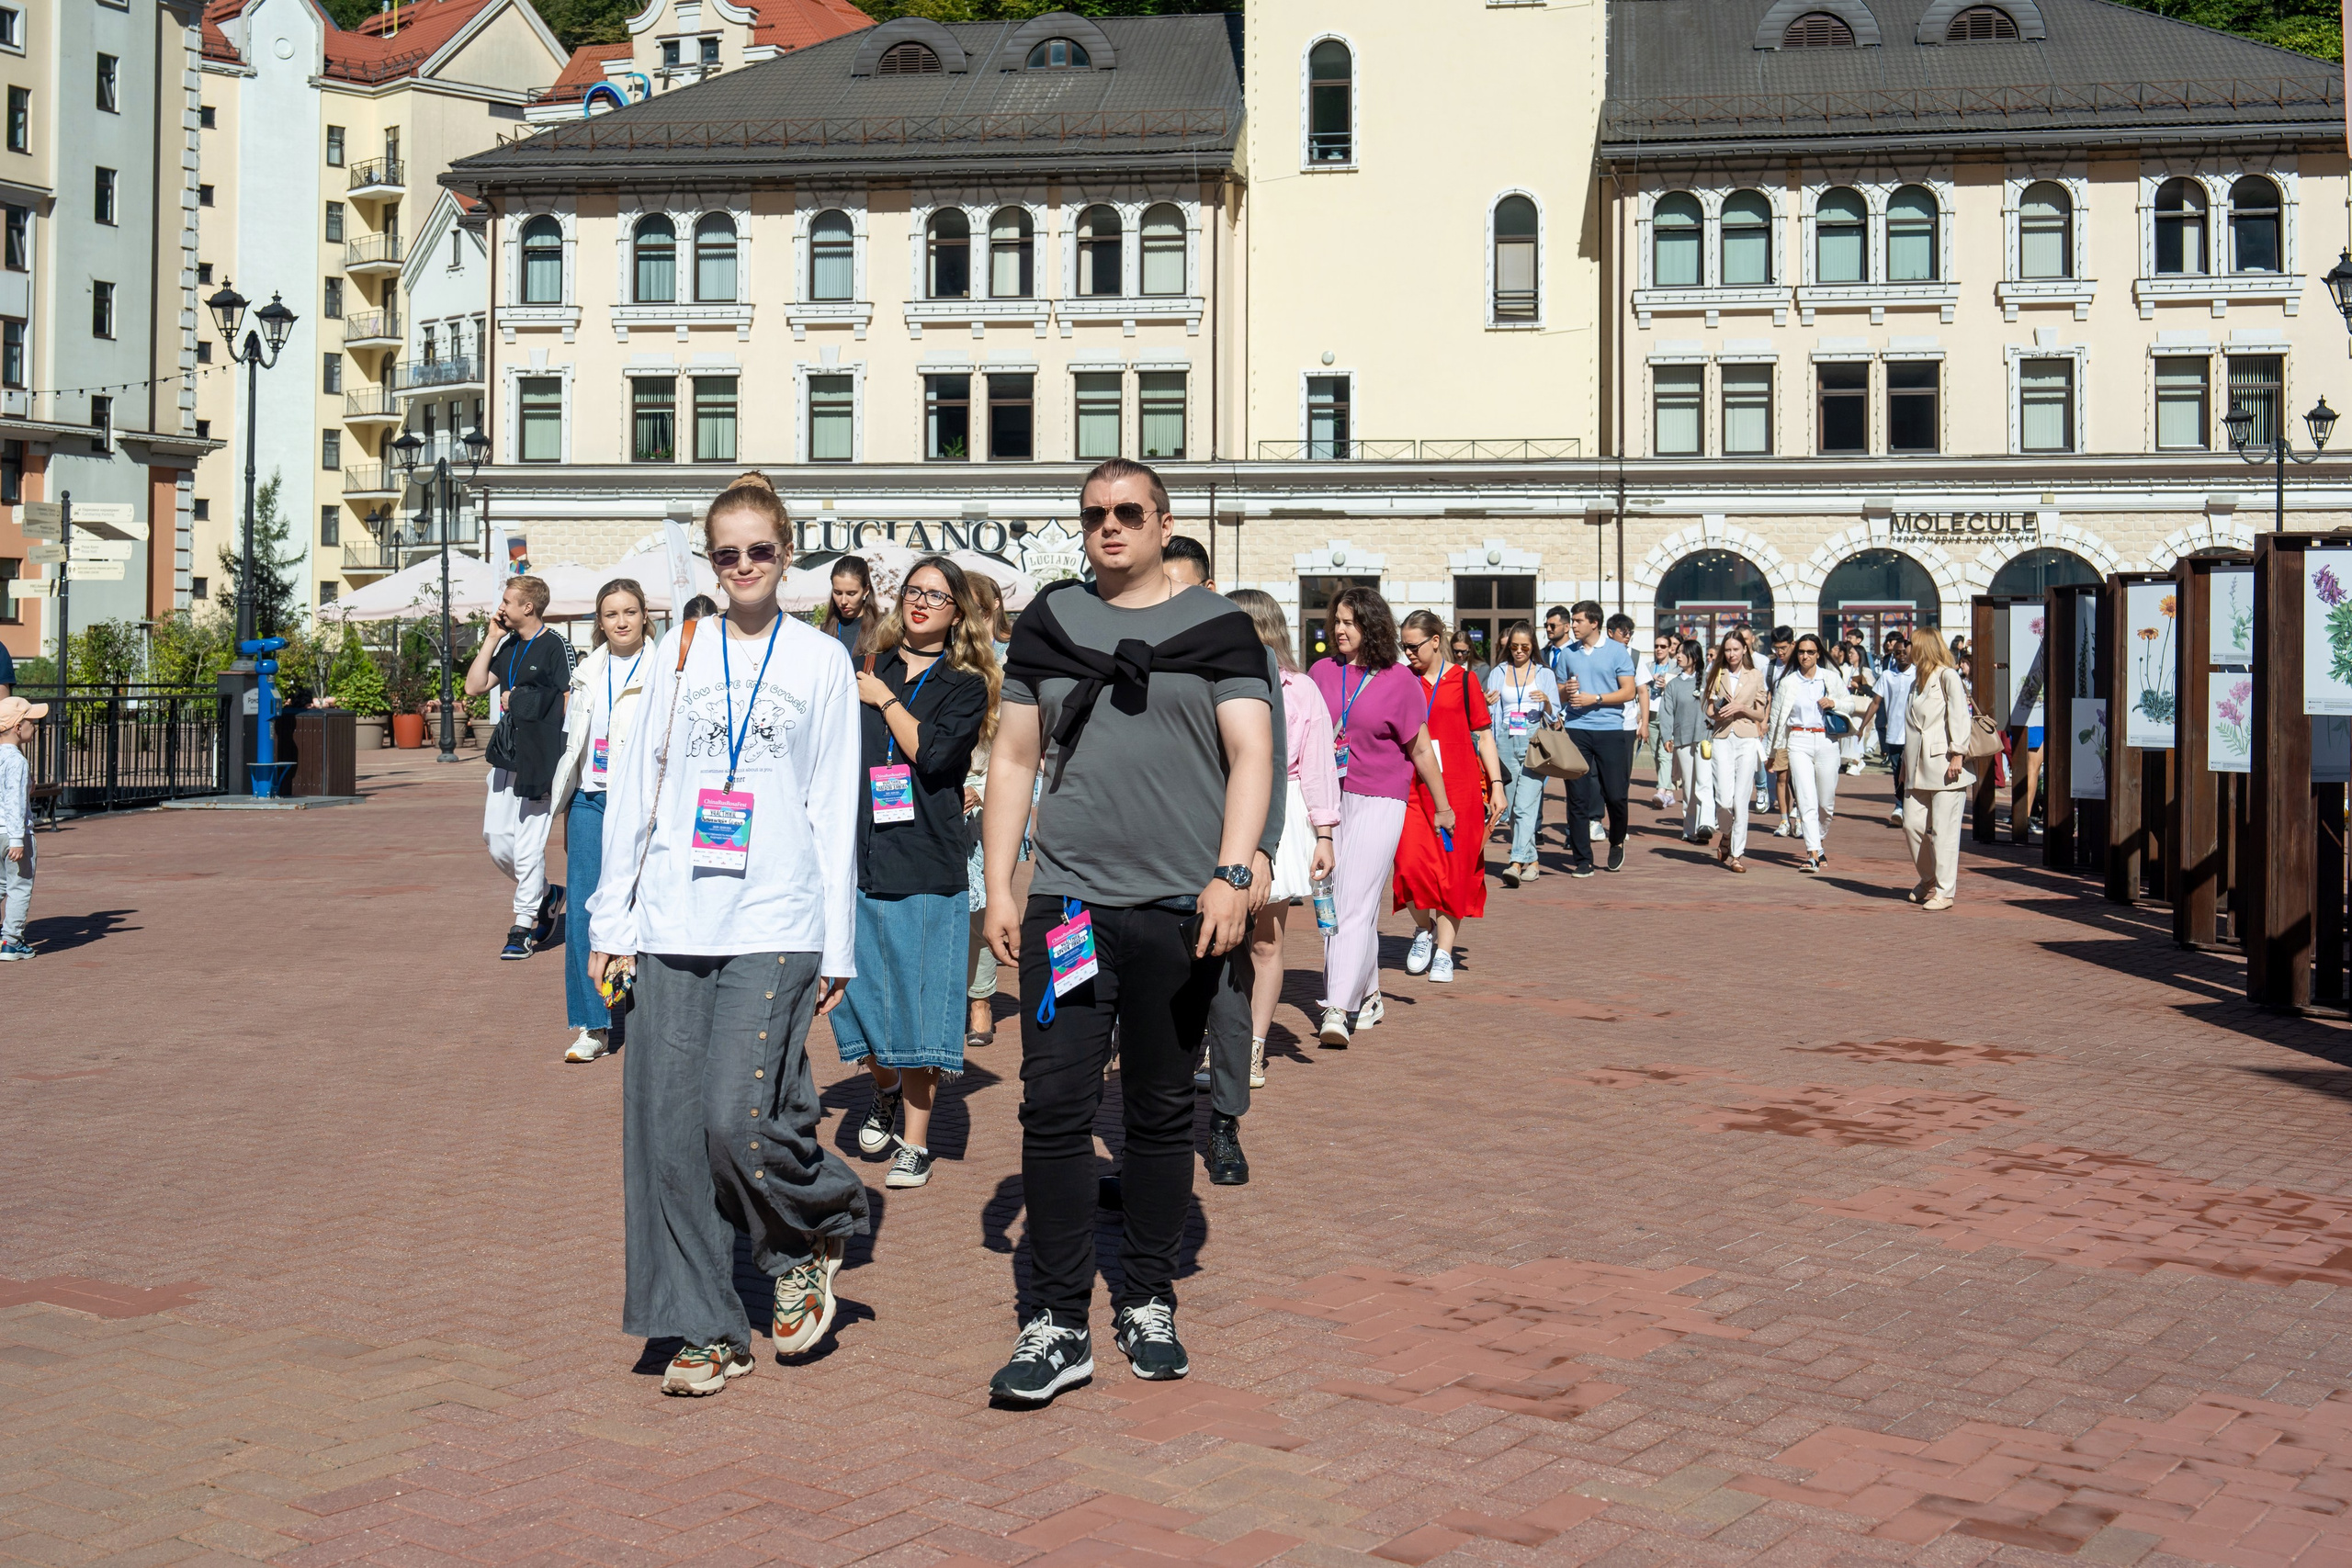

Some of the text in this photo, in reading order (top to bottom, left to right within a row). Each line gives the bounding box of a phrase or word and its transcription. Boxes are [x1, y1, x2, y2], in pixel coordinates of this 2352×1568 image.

[1891, 512, 2037, 532] MOLECULE
[793, 519, 1008, 553] LUCIANO
[1029, 554, 1077, 567] LUCIANO
[683, 686, 711, 705] You
[746, 680, 768, 693] my
[770, 684, 807, 714] crush
[704, 799, 747, 807] ChinaRusRosaFest
[1052, 921, 1086, 943] ChinaRusRosaFest
